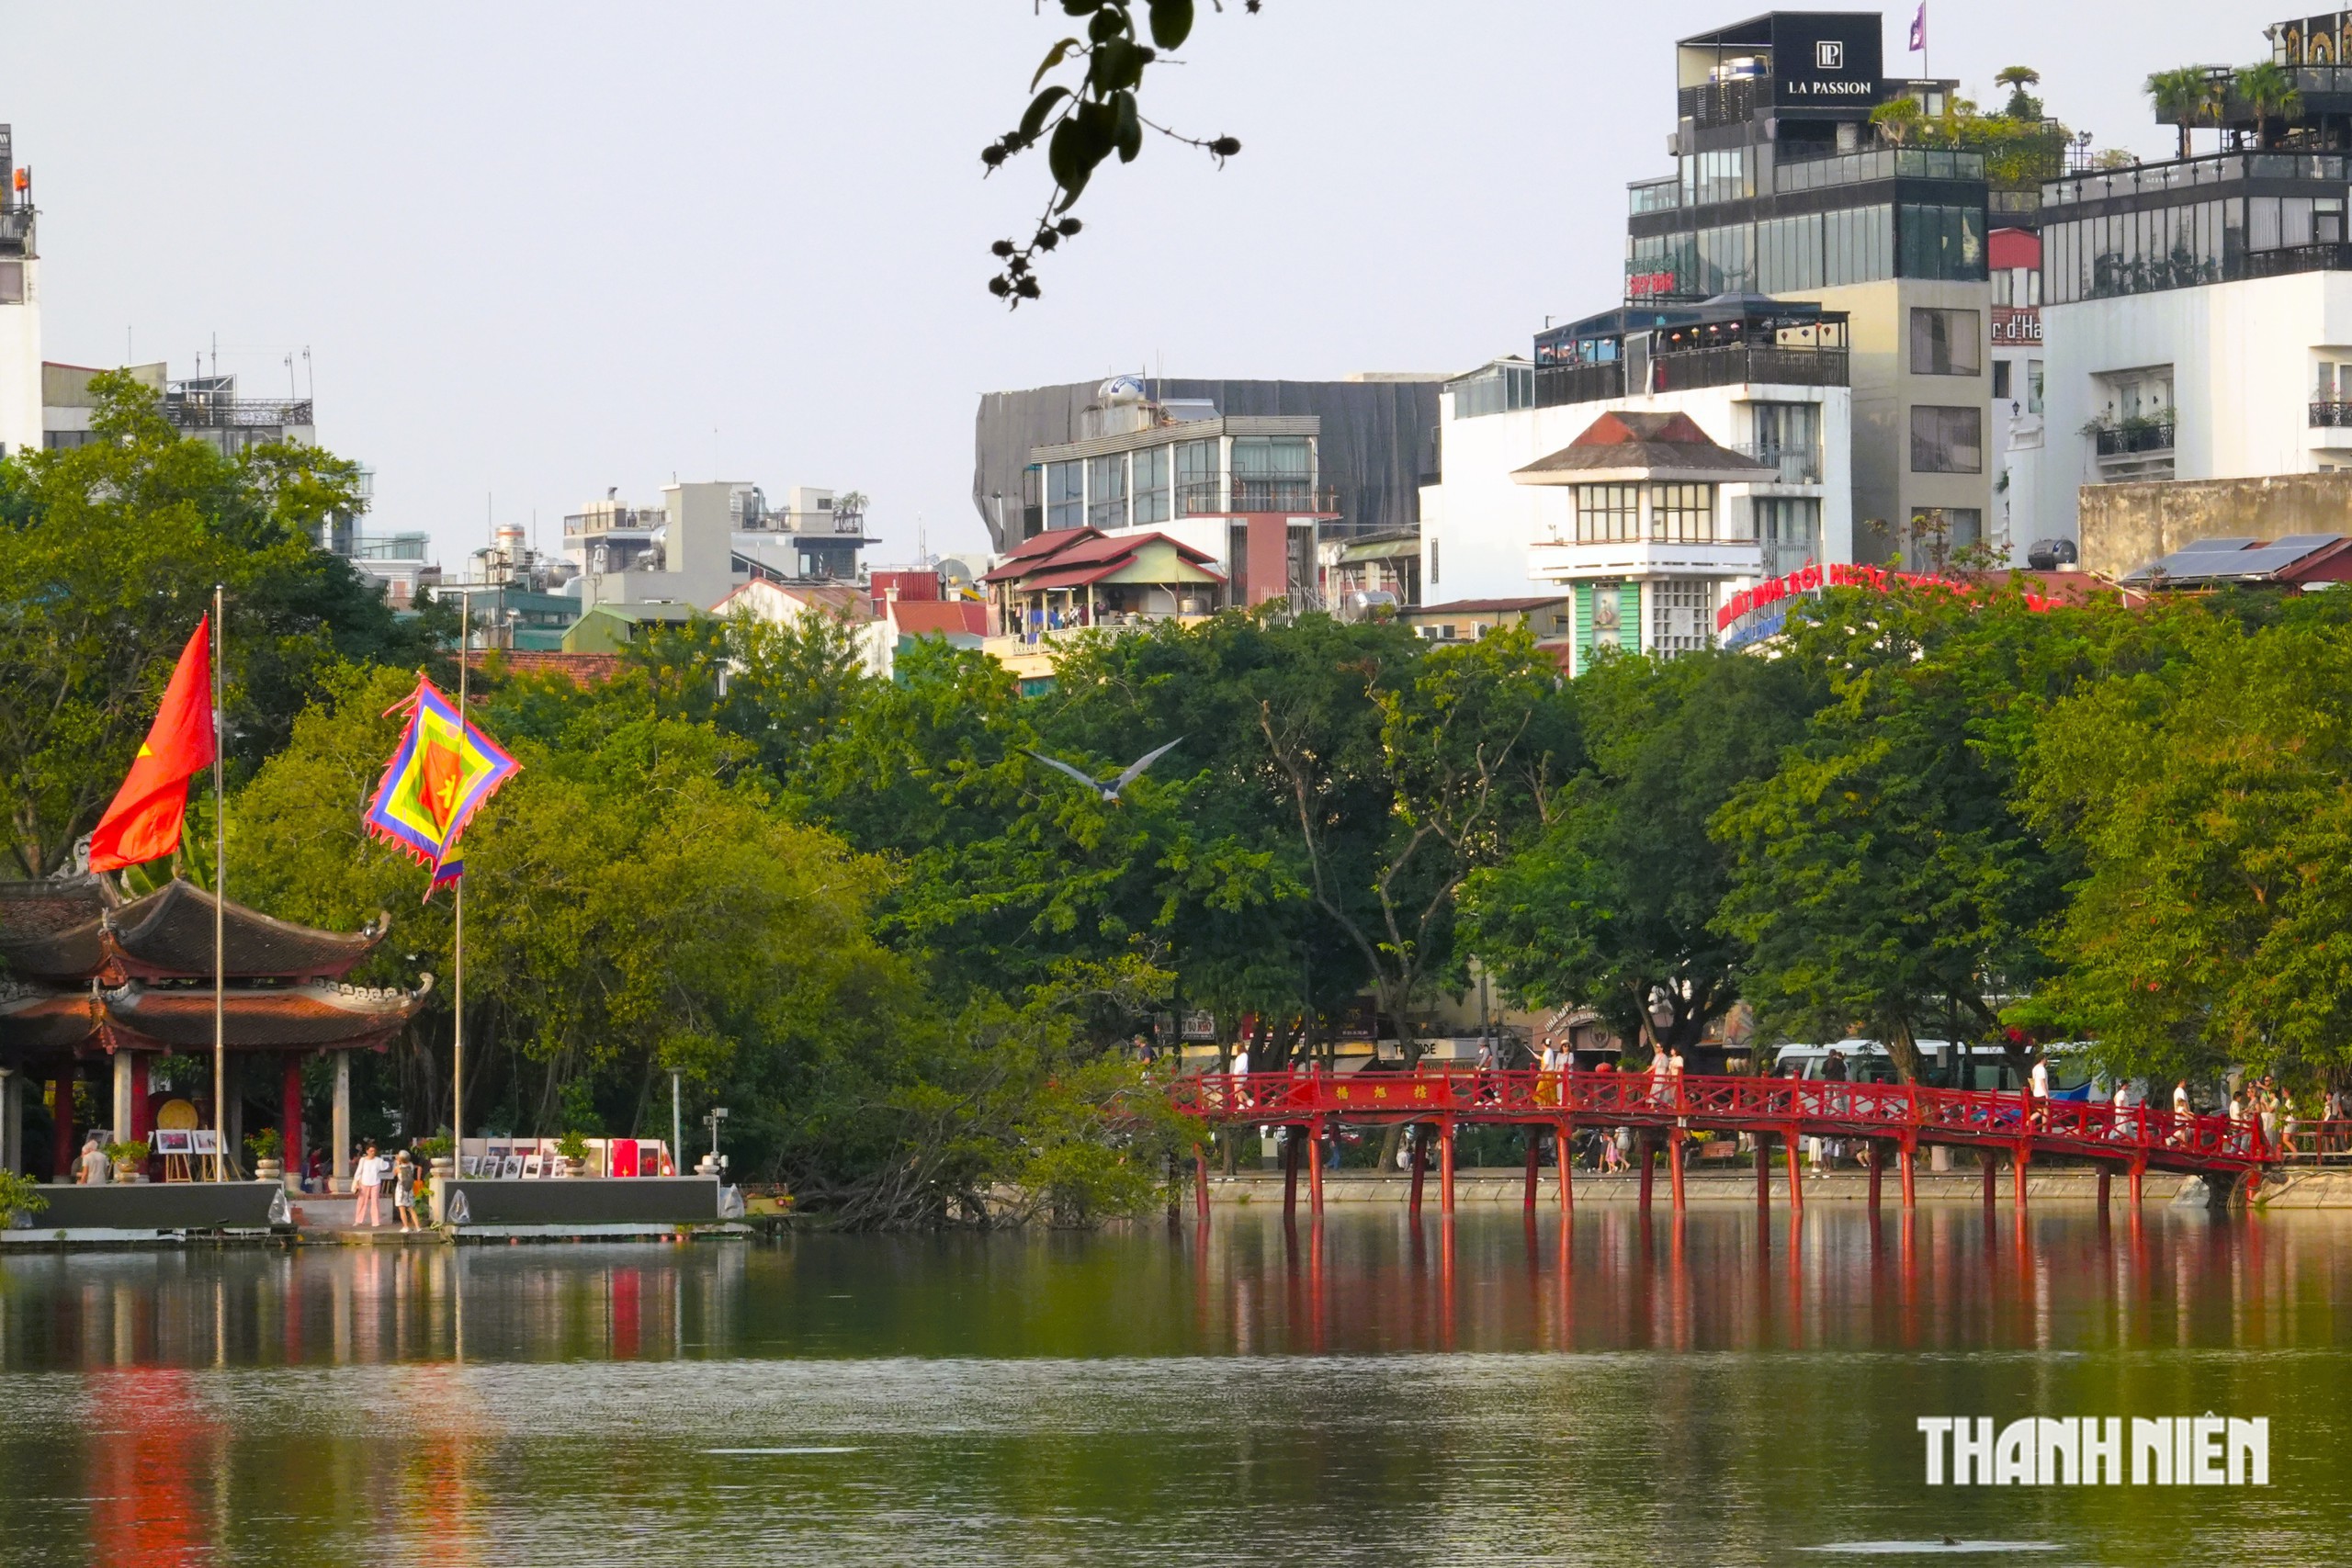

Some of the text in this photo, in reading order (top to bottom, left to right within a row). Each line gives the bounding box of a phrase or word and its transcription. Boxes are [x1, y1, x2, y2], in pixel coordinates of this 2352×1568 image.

[1789, 81, 1871, 94] LA PASSION
[1652, 272, 1674, 292] BAR
[1788, 557, 1823, 595] RỐI
